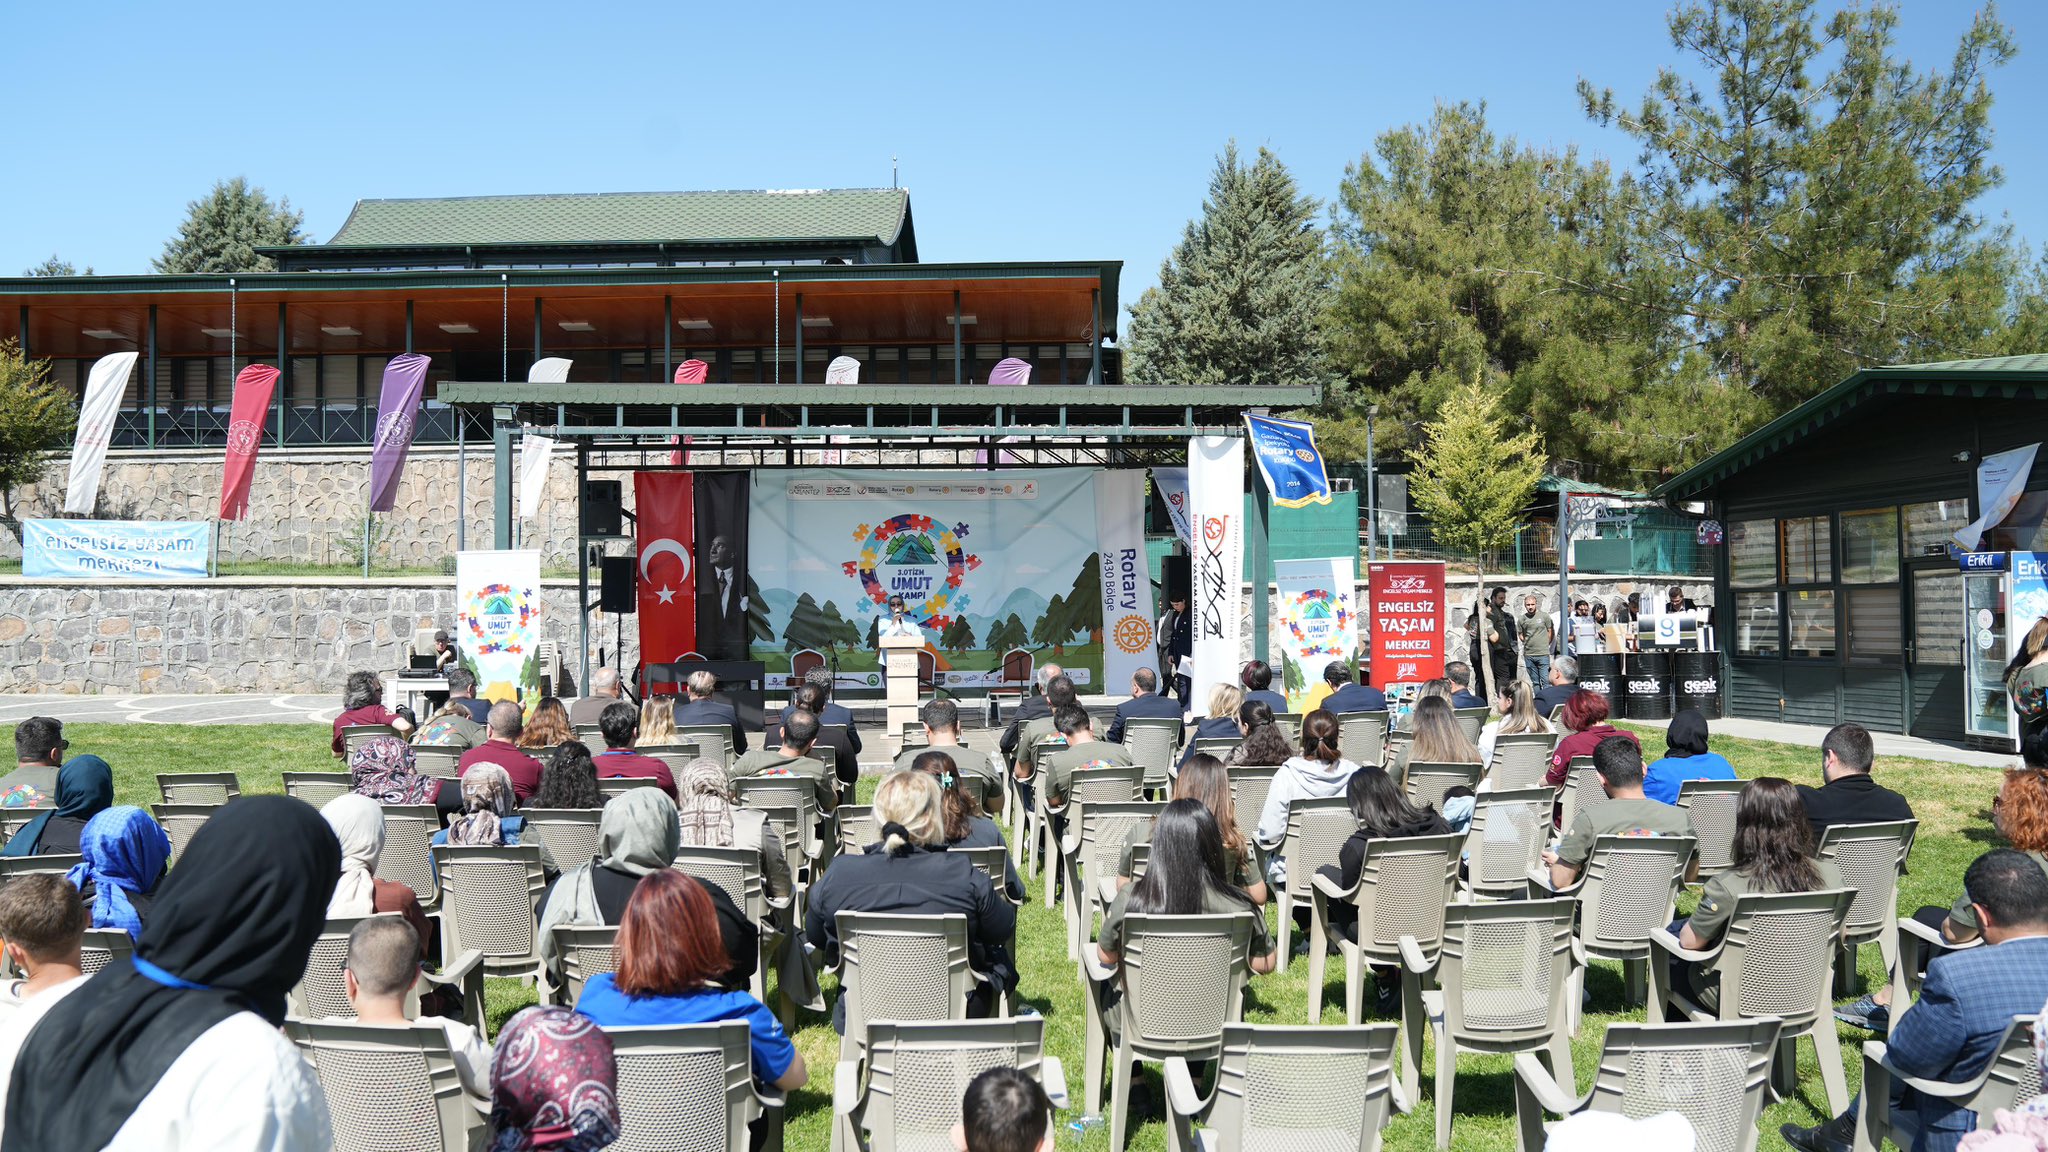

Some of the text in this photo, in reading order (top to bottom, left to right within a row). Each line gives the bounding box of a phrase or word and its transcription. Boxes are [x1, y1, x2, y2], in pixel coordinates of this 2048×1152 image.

[1260, 446, 1294, 456] Rotary
[1967, 554, 1993, 566] Erikli
[891, 576, 933, 590] UMUT
[1103, 552, 1116, 611] 2430 Bölge
[1120, 548, 1136, 610] Rotary
[1378, 600, 1435, 613] ENGELSİZ
[488, 621, 511, 629] UMUT
[1307, 624, 1330, 633] UMUT
[1378, 618, 1435, 636] YAŞAM
[1661, 618, 1674, 637] g
[1384, 640, 1431, 650] MERKEZİ
[1628, 678, 1661, 693] geek
[1684, 677, 1717, 693] geek
